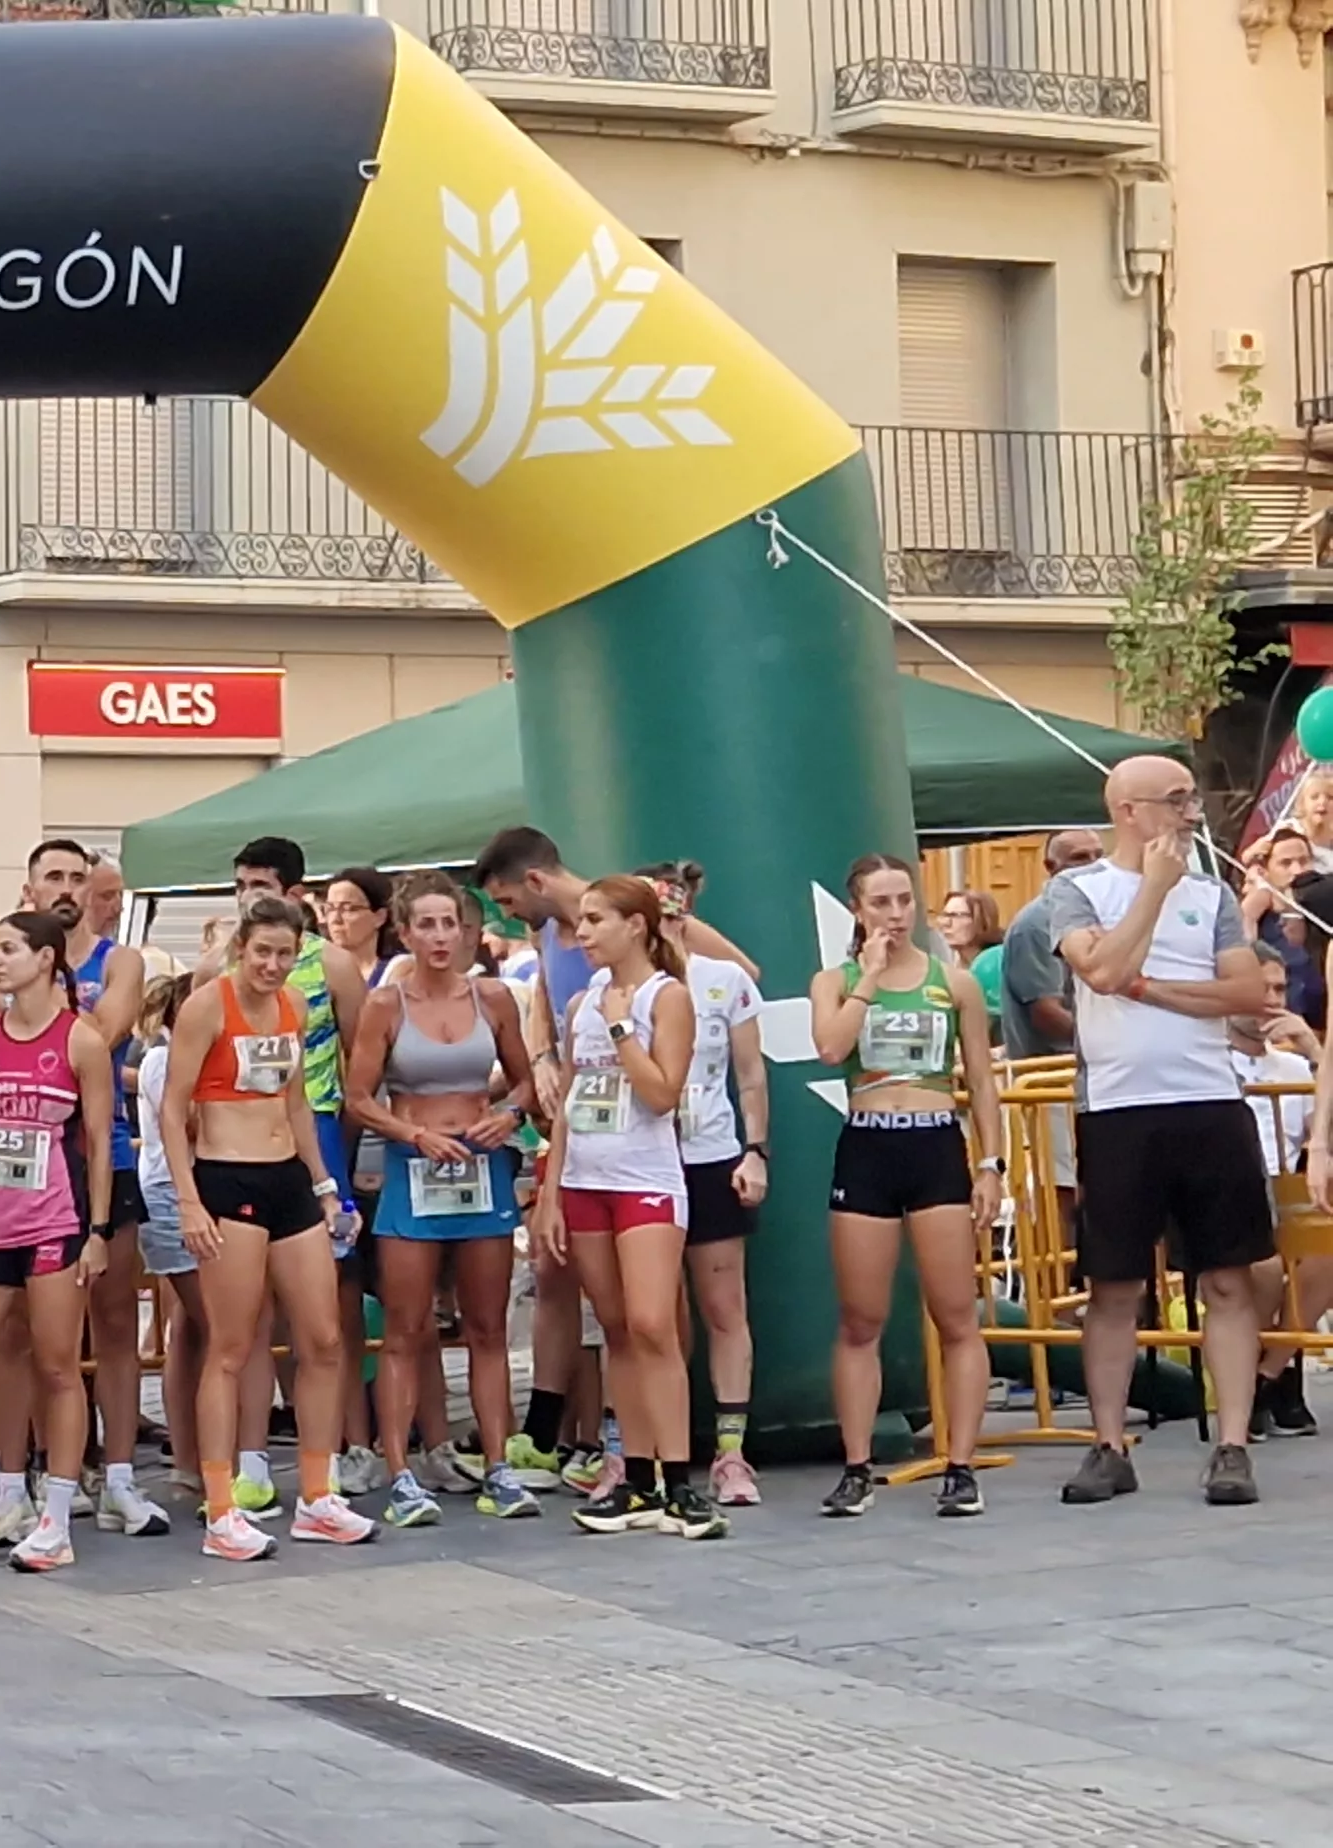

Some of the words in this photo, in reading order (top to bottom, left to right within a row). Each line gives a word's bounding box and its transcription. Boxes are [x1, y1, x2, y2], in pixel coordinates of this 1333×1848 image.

[100, 681, 217, 726] GAES
[885, 1012, 920, 1032] 23
[258, 1036, 279, 1056] 27
[584, 1075, 608, 1095] 21
[851, 1110, 952, 1129] UNDER
[434, 1160, 467, 1179] 29
